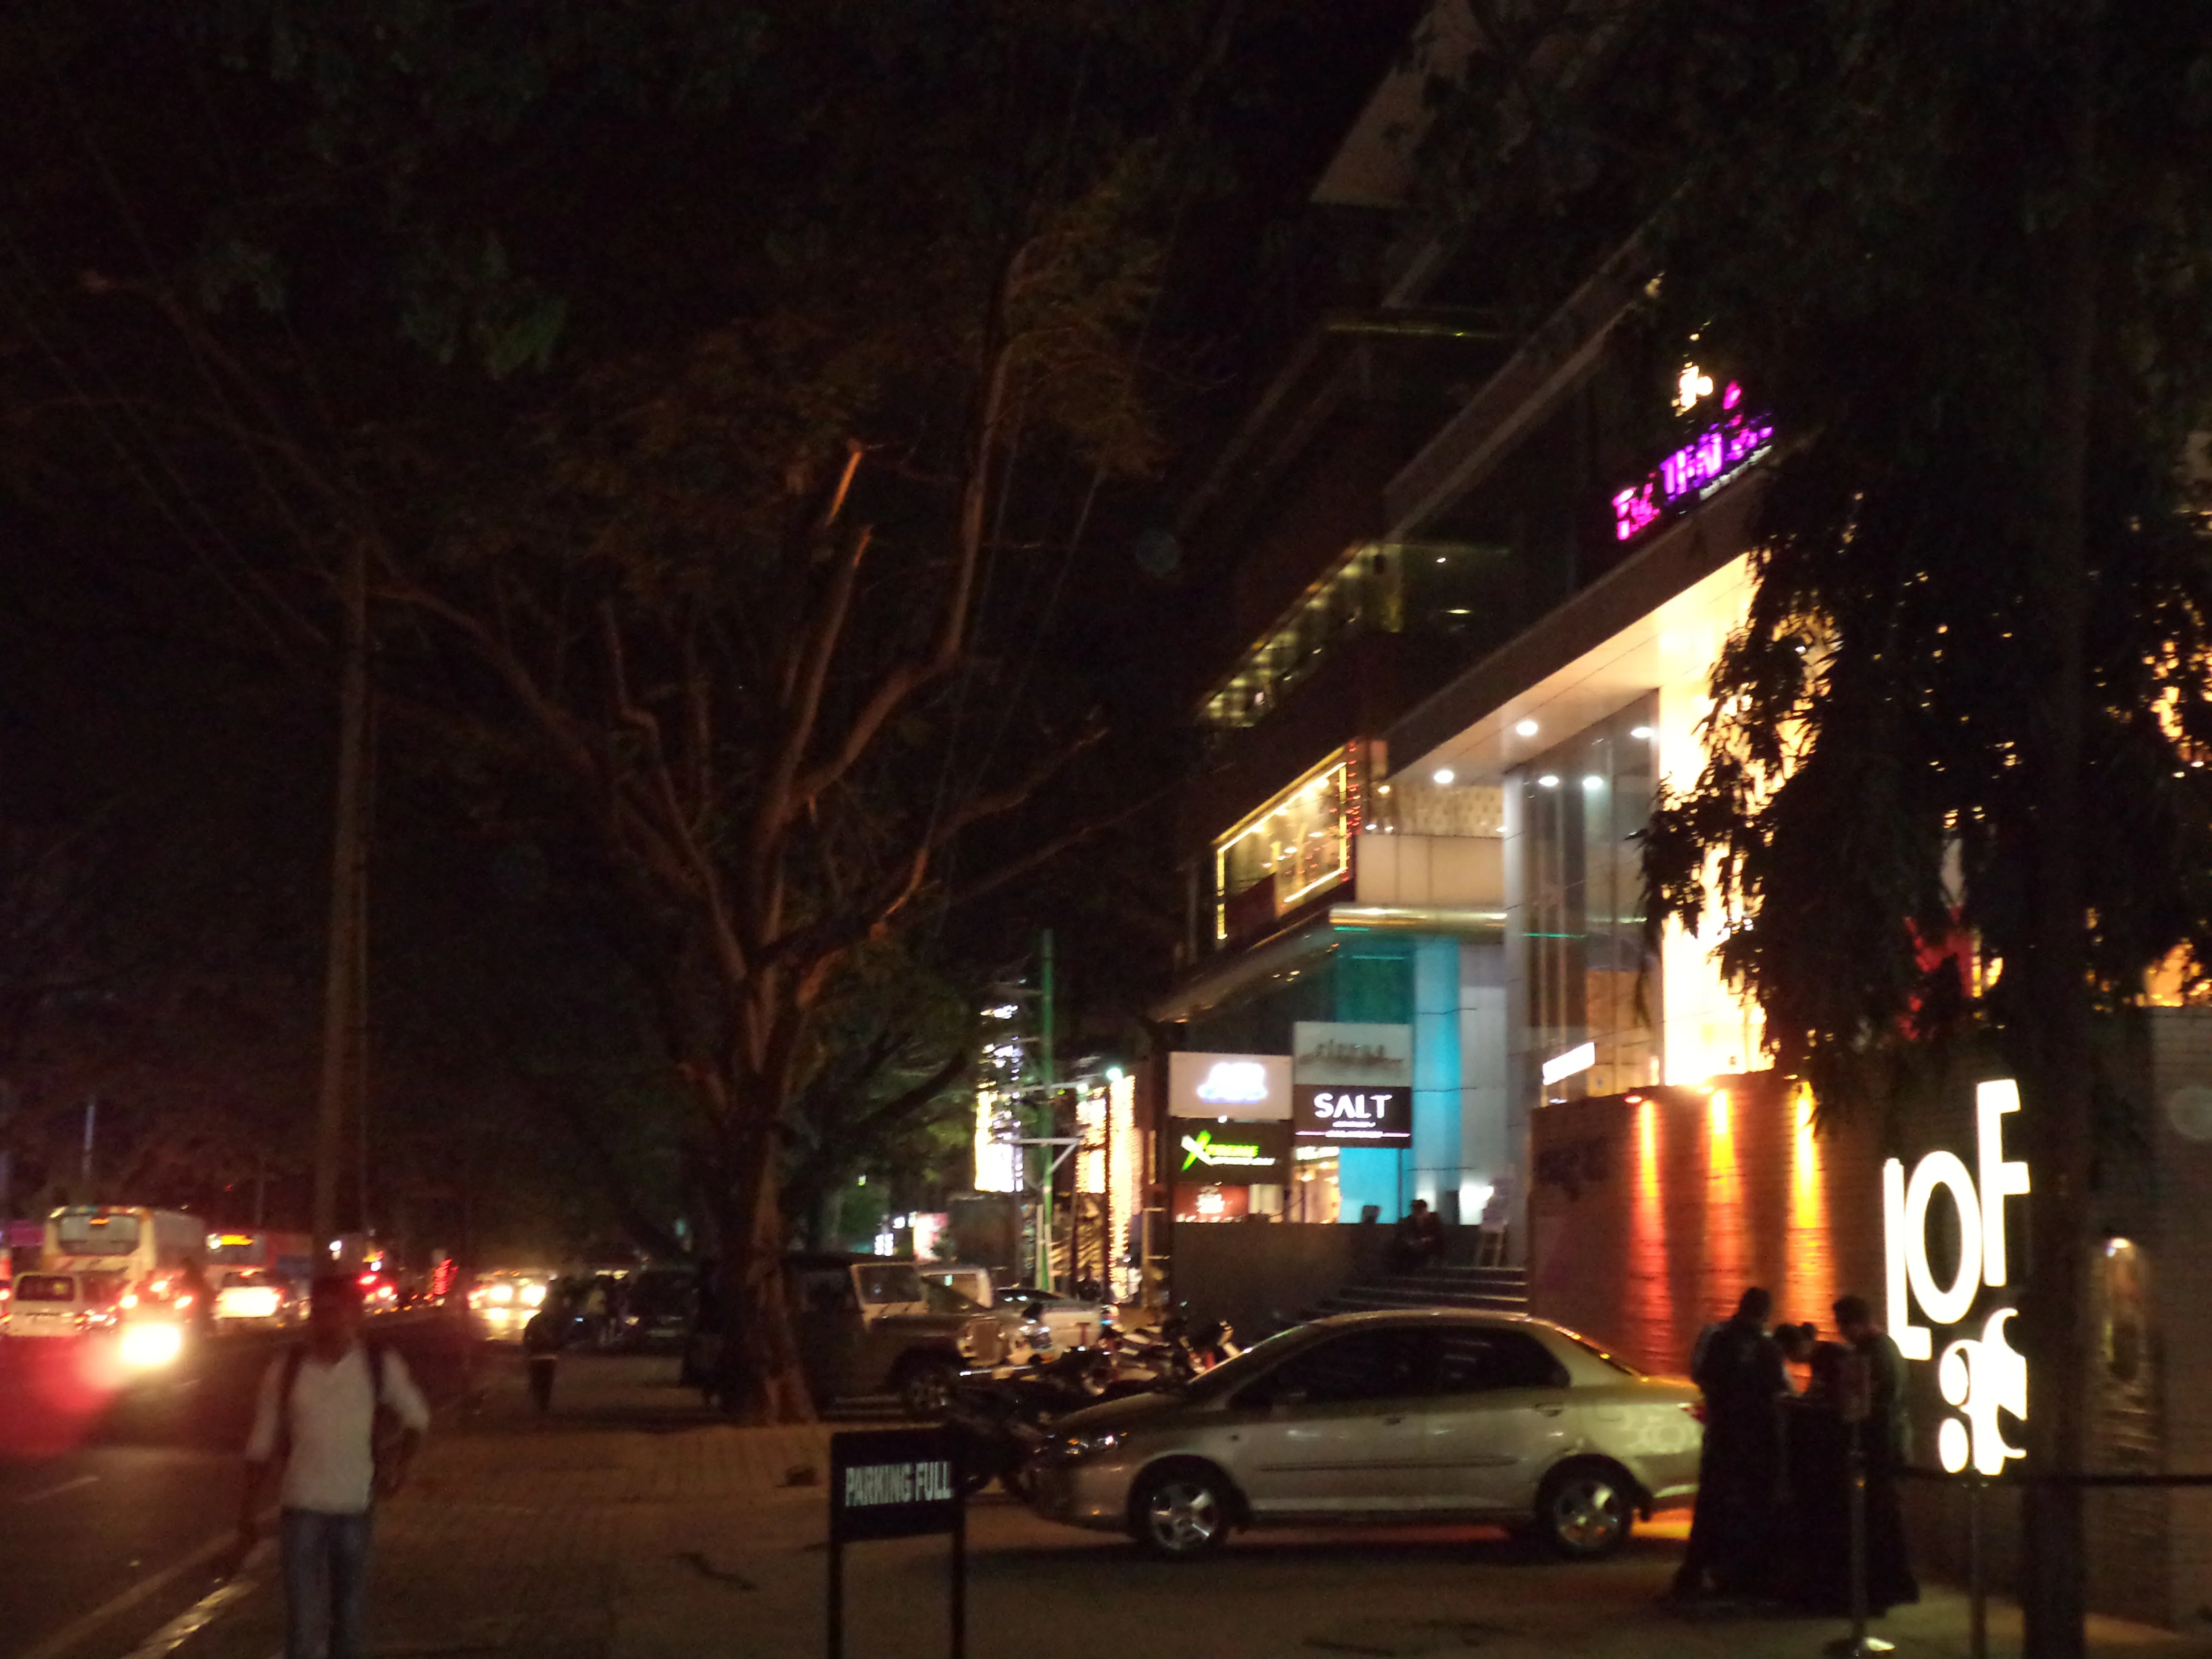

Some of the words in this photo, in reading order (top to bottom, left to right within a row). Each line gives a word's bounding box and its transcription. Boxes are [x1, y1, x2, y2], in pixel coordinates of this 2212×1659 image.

[1313, 1093, 1393, 1118] SALT
[845, 1464, 912, 1507] PARKING
[915, 1461, 953, 1502] FULL
